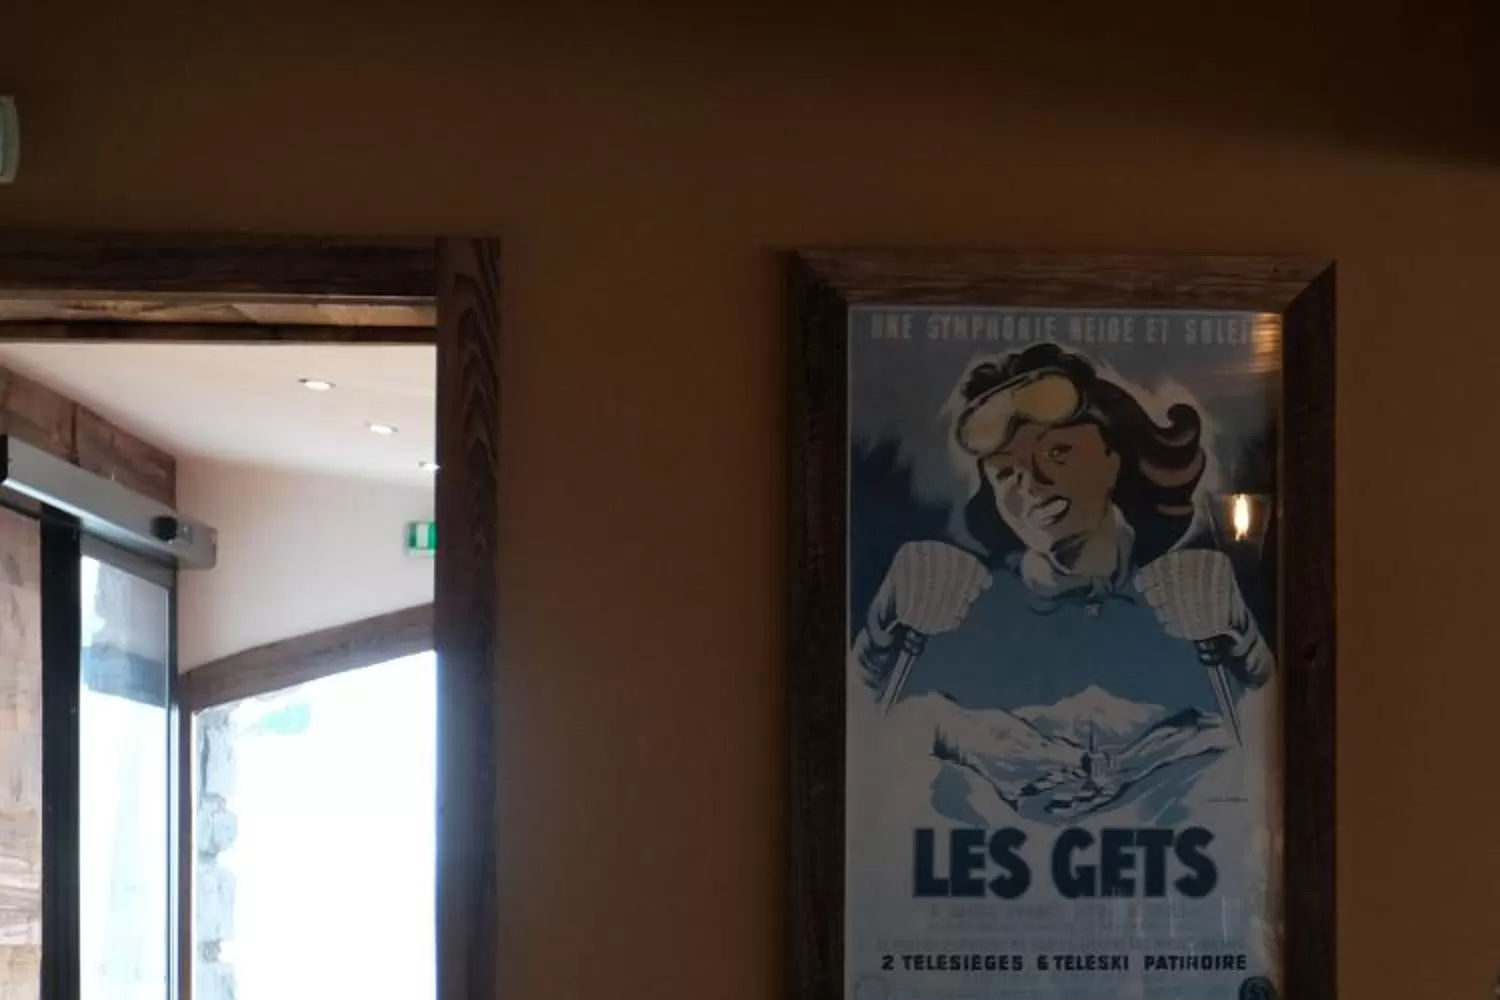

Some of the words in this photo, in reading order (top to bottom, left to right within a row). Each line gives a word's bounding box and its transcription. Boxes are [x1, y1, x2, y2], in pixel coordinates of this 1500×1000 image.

[871, 312, 913, 340] UNE
[927, 313, 1057, 341] SYMPHONIE
[1069, 315, 1134, 343] NEIGE
[1146, 317, 1170, 344] ET
[1185, 318, 1251, 345] SOLEI
[913, 827, 1032, 899] LES
[1052, 827, 1218, 899] GETS
[881, 955, 895, 971] 2
[902, 954, 1024, 972] TELESIEGES
[1036, 955, 1049, 971] 6
[1053, 955, 1130, 972] TELESKI
[1144, 955, 1248, 972] PATINOIRE
